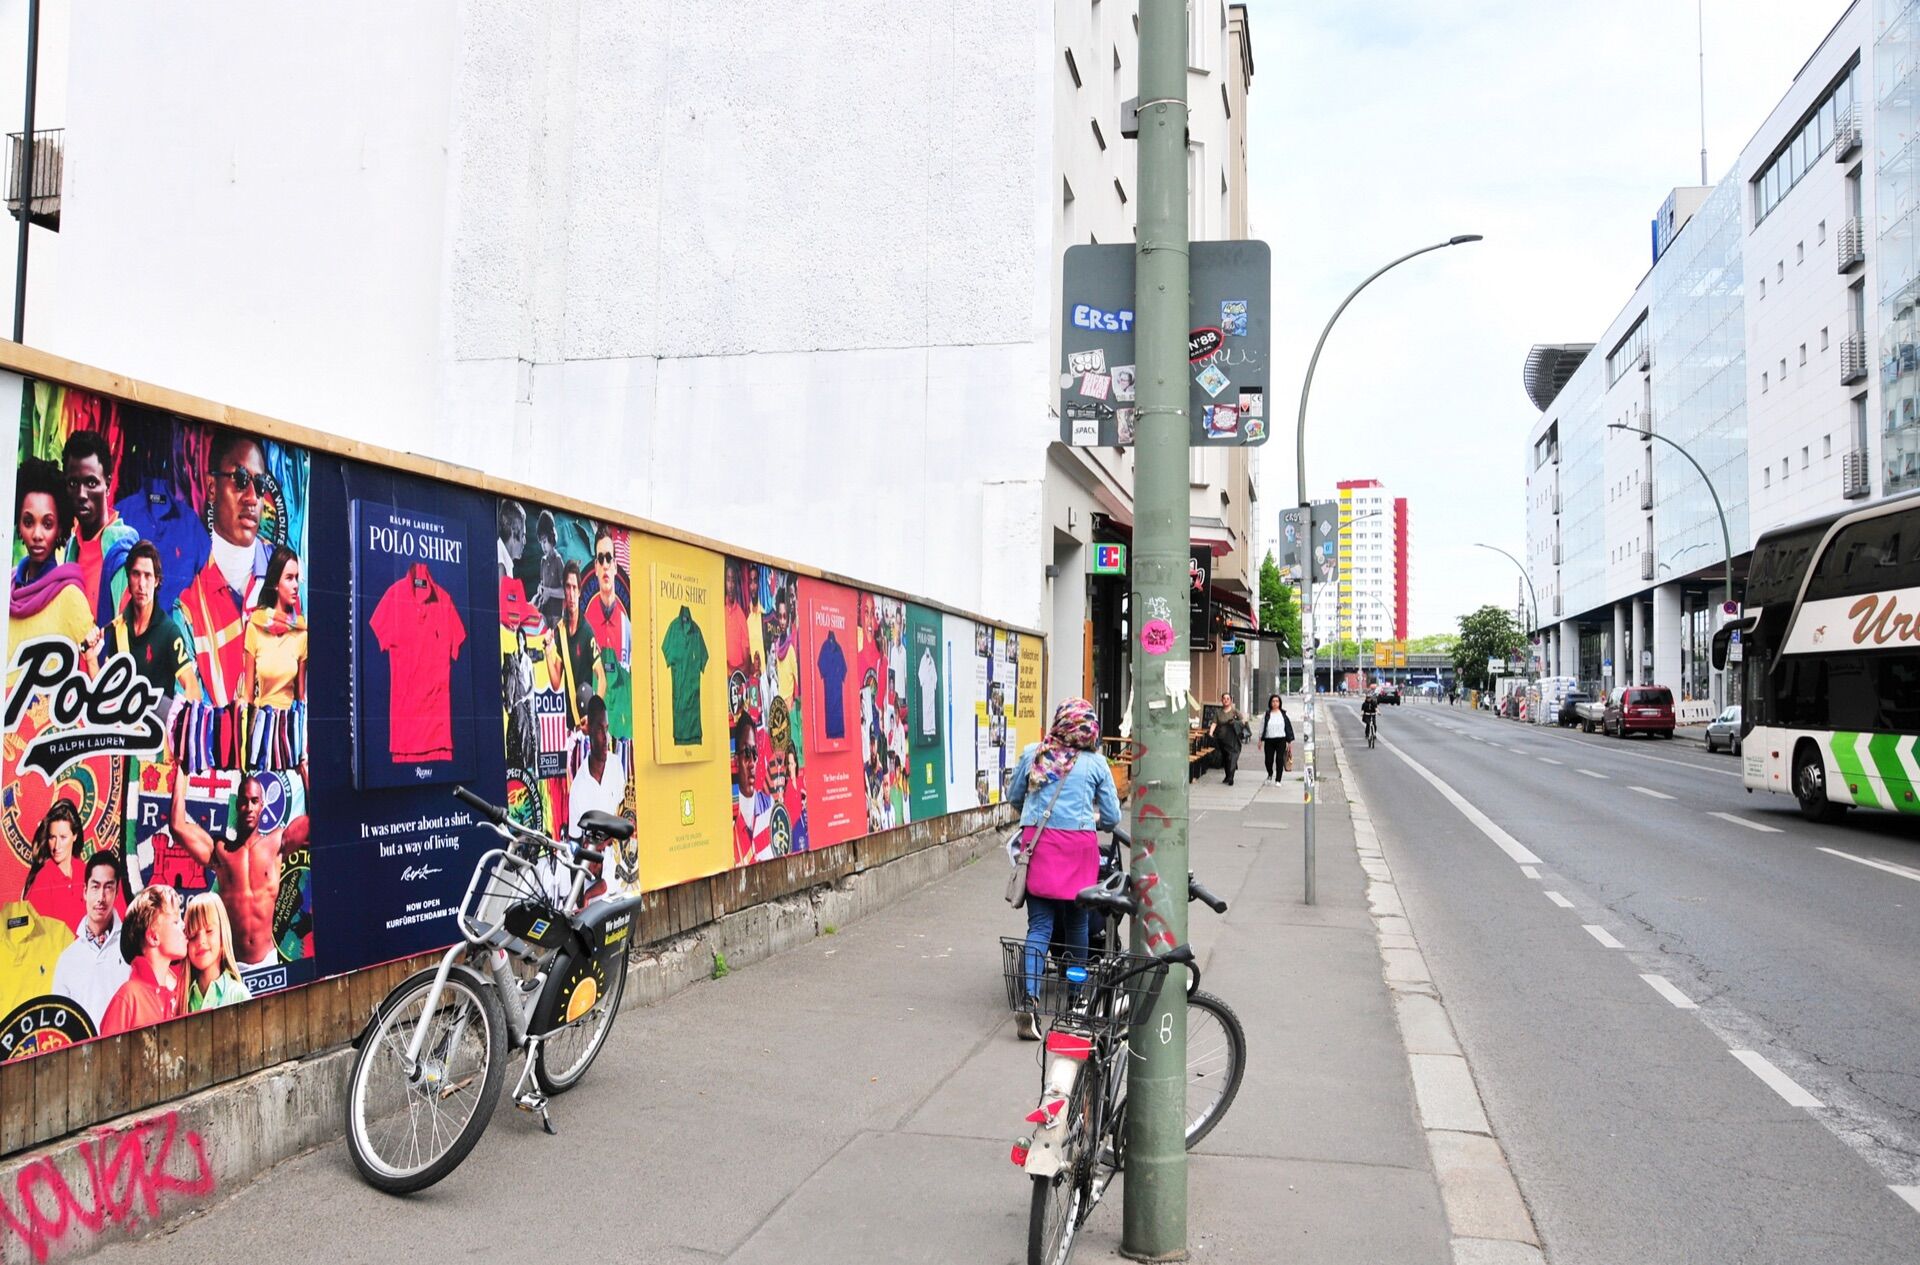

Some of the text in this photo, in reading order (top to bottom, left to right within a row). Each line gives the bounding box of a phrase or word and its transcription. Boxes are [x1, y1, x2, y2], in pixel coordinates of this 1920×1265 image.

[1074, 305, 1133, 330] ERST
[1189, 332, 1217, 351] N'88
[265, 474, 287, 546] ECT WILDLIFE
[389, 515, 445, 533] RALPH LAUREN'S
[369, 525, 462, 564] POLO SHIRT
[660, 580, 707, 605] POLO SHIRT
[816, 611, 845, 630] POLO SHIRT
[1848, 594, 1920, 645] Ur
[4, 641, 158, 727] Polo
[535, 695, 563, 712] POLO
[50, 737, 126, 755] RALPH LAUREN
[541, 756, 557, 766] Polo
[506, 767, 521, 780] PECT
[98, 768, 121, 836] CHALLENGE
[141, 802, 160, 827] R
[209, 808, 223, 833] L
[361, 811, 473, 838] It was never about a shirt,
[380, 834, 460, 857] but a way of living
[406, 898, 440, 912] NOW OPEN
[386, 908, 448, 929] KURFÜRSTENDAMM
[246, 974, 283, 991] Polo
[2, 1009, 67, 1051] POLO
